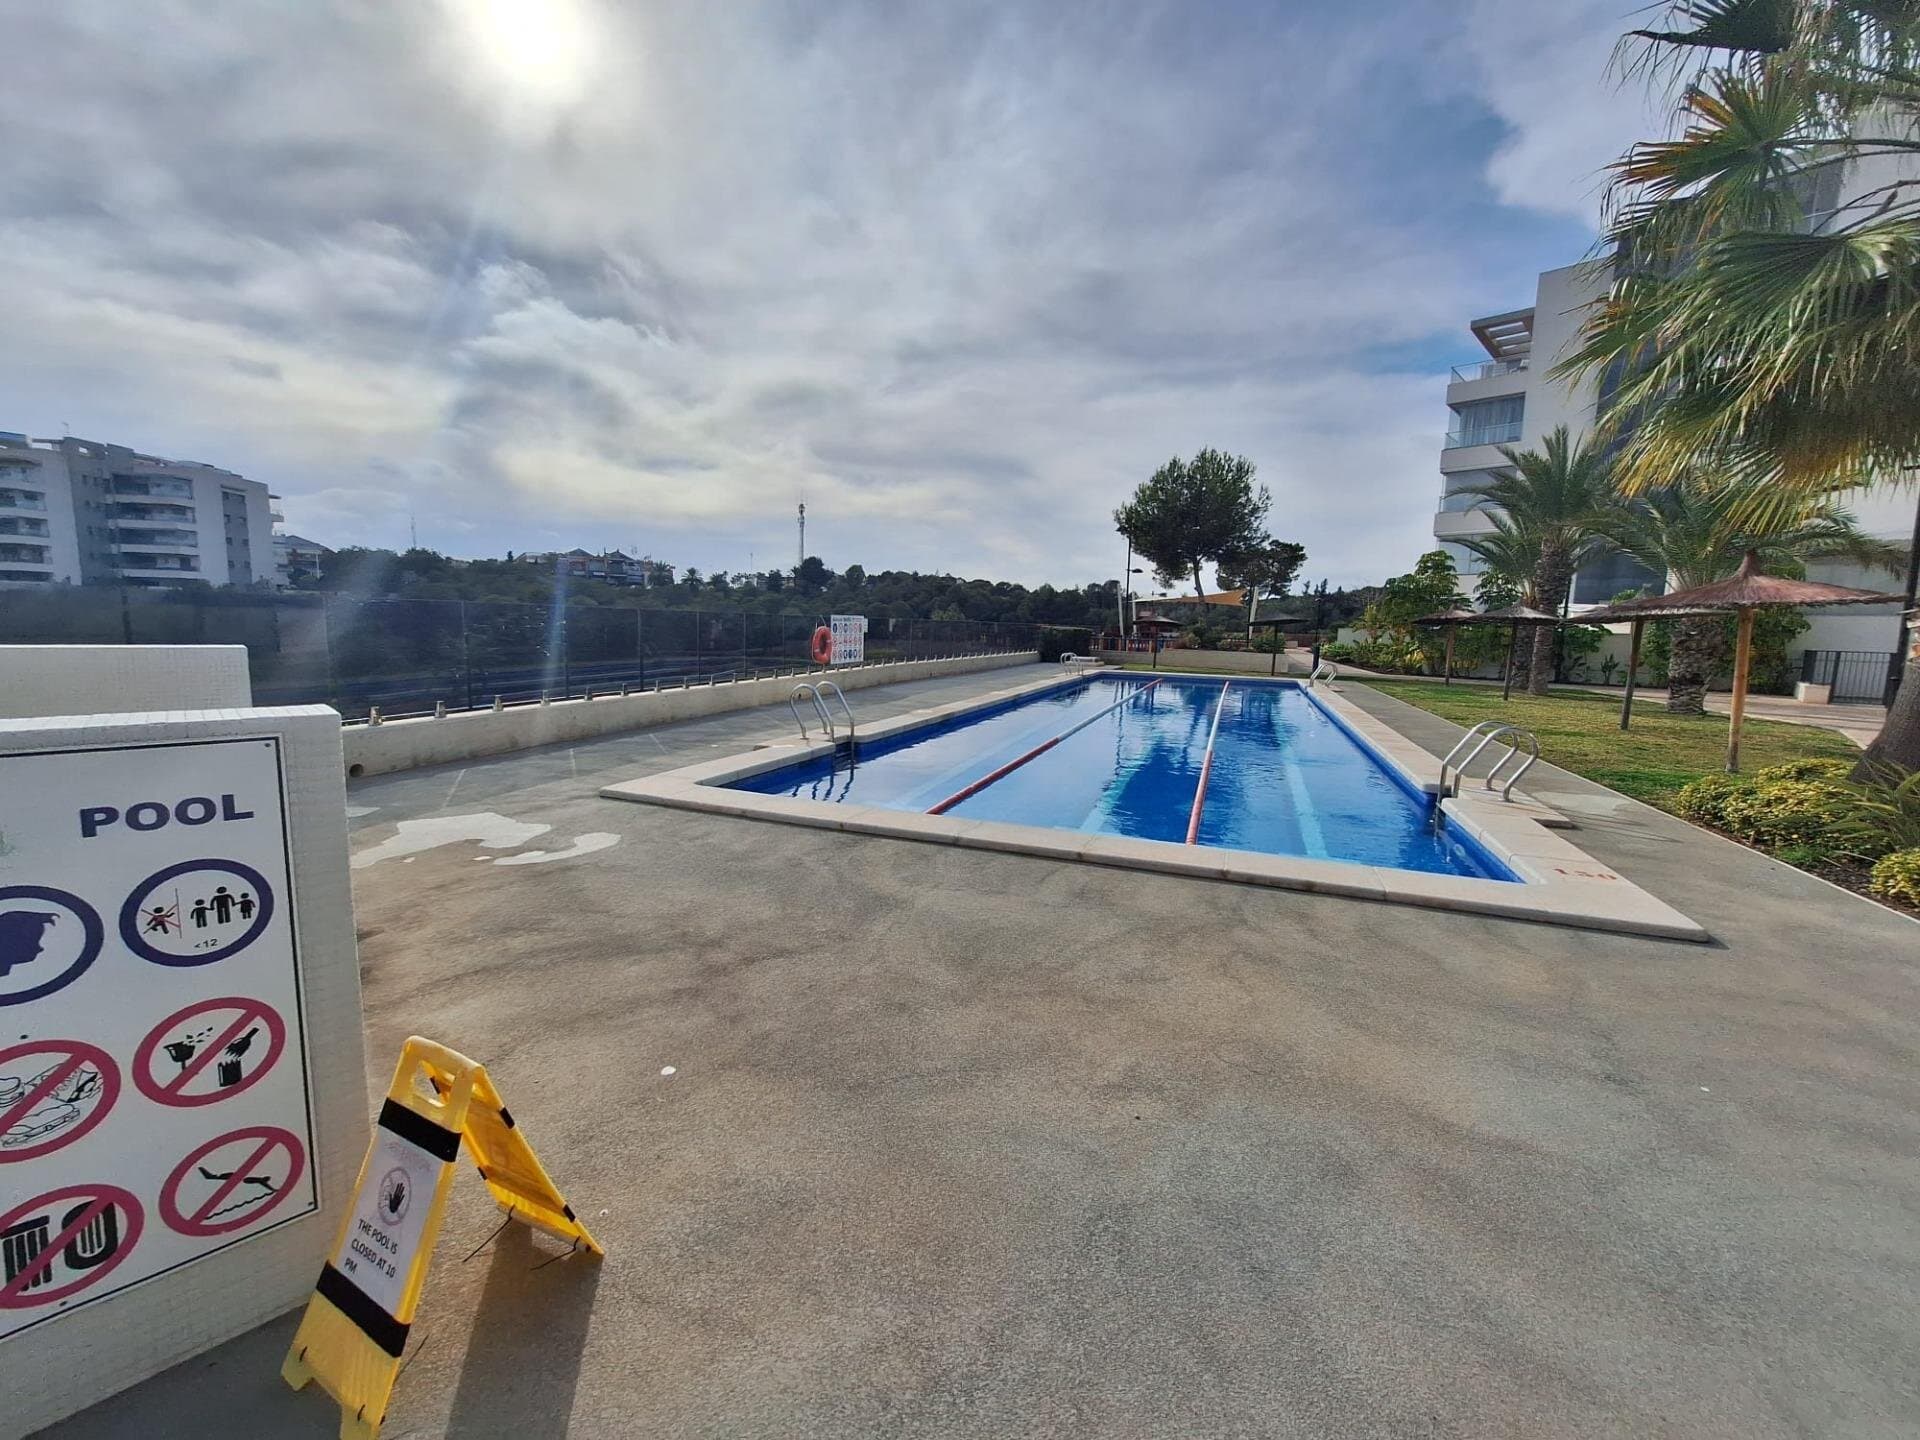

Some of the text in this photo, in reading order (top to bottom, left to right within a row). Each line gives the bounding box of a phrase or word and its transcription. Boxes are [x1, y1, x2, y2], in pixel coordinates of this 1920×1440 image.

[80, 794, 254, 838] POOL
[358, 1218, 398, 1255] THE POOL IS
[344, 1257, 358, 1274] PM
[351, 1238, 396, 1278] CLOSED AT 10
